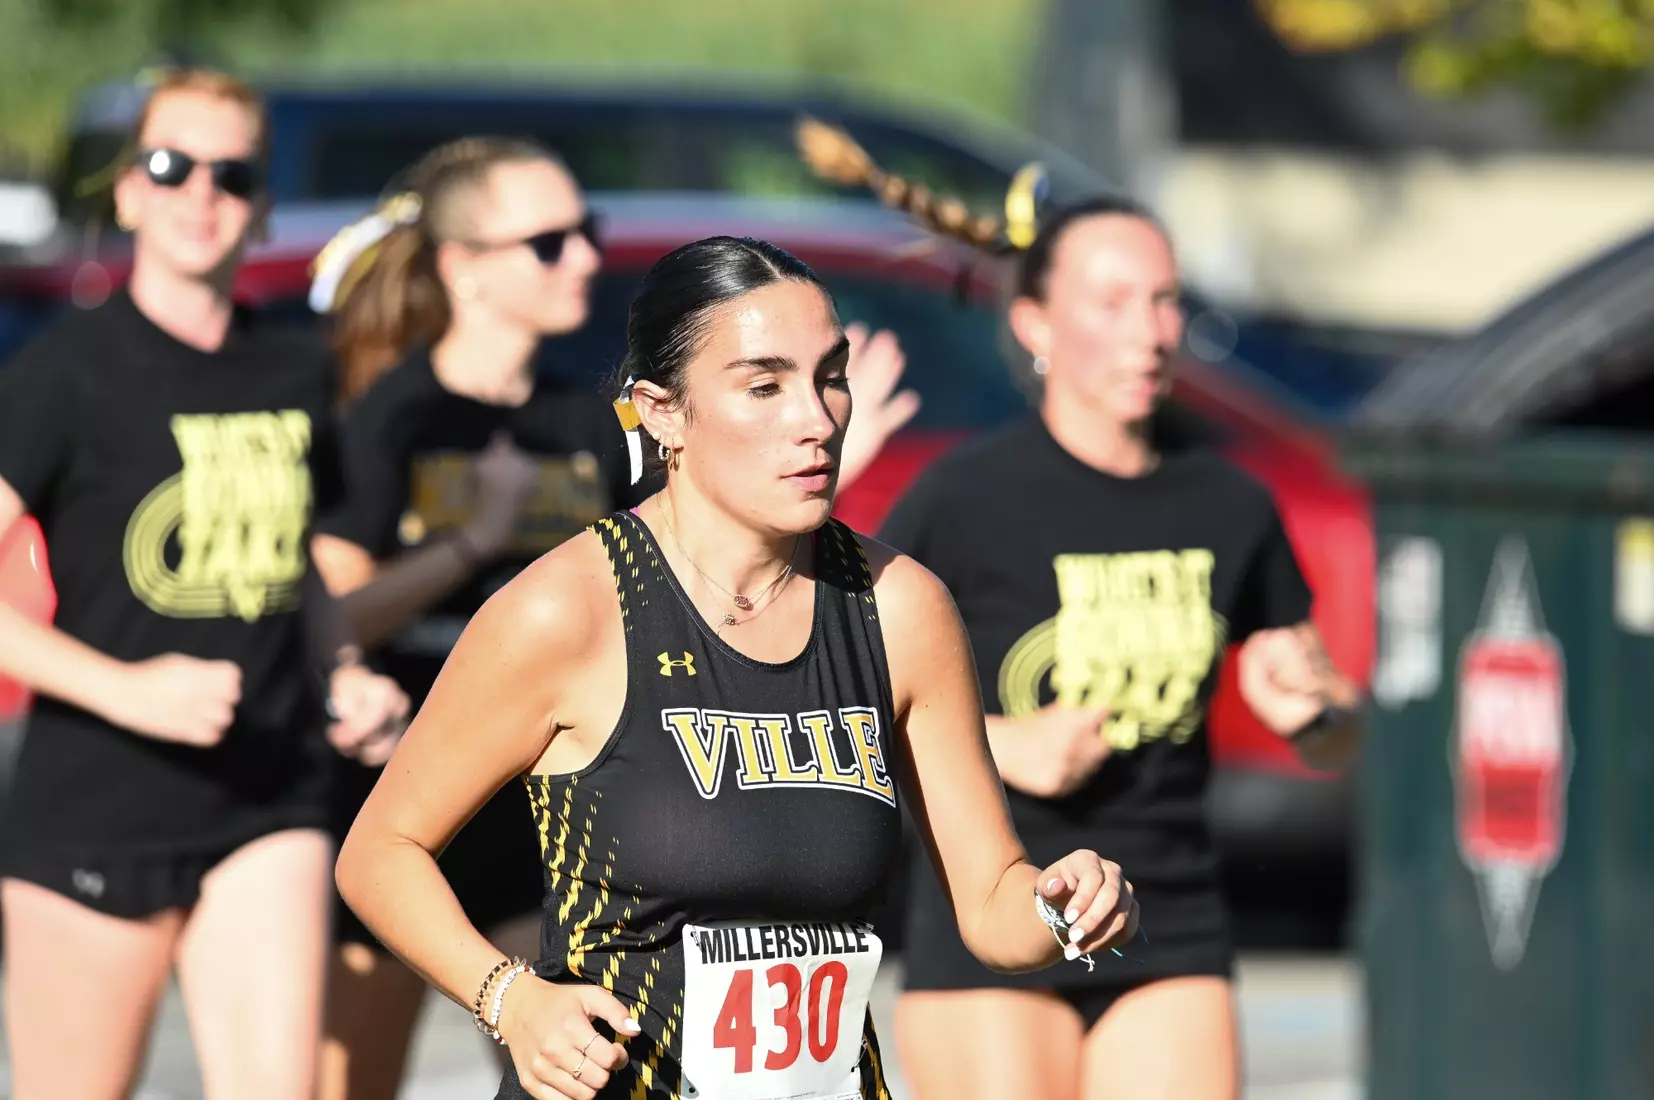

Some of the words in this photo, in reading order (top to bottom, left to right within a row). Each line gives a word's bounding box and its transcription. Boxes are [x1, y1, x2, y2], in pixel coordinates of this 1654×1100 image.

[661, 706, 897, 809] VILLE
[700, 922, 869, 964] MILLERSVILLE
[712, 960, 848, 1074] 430
